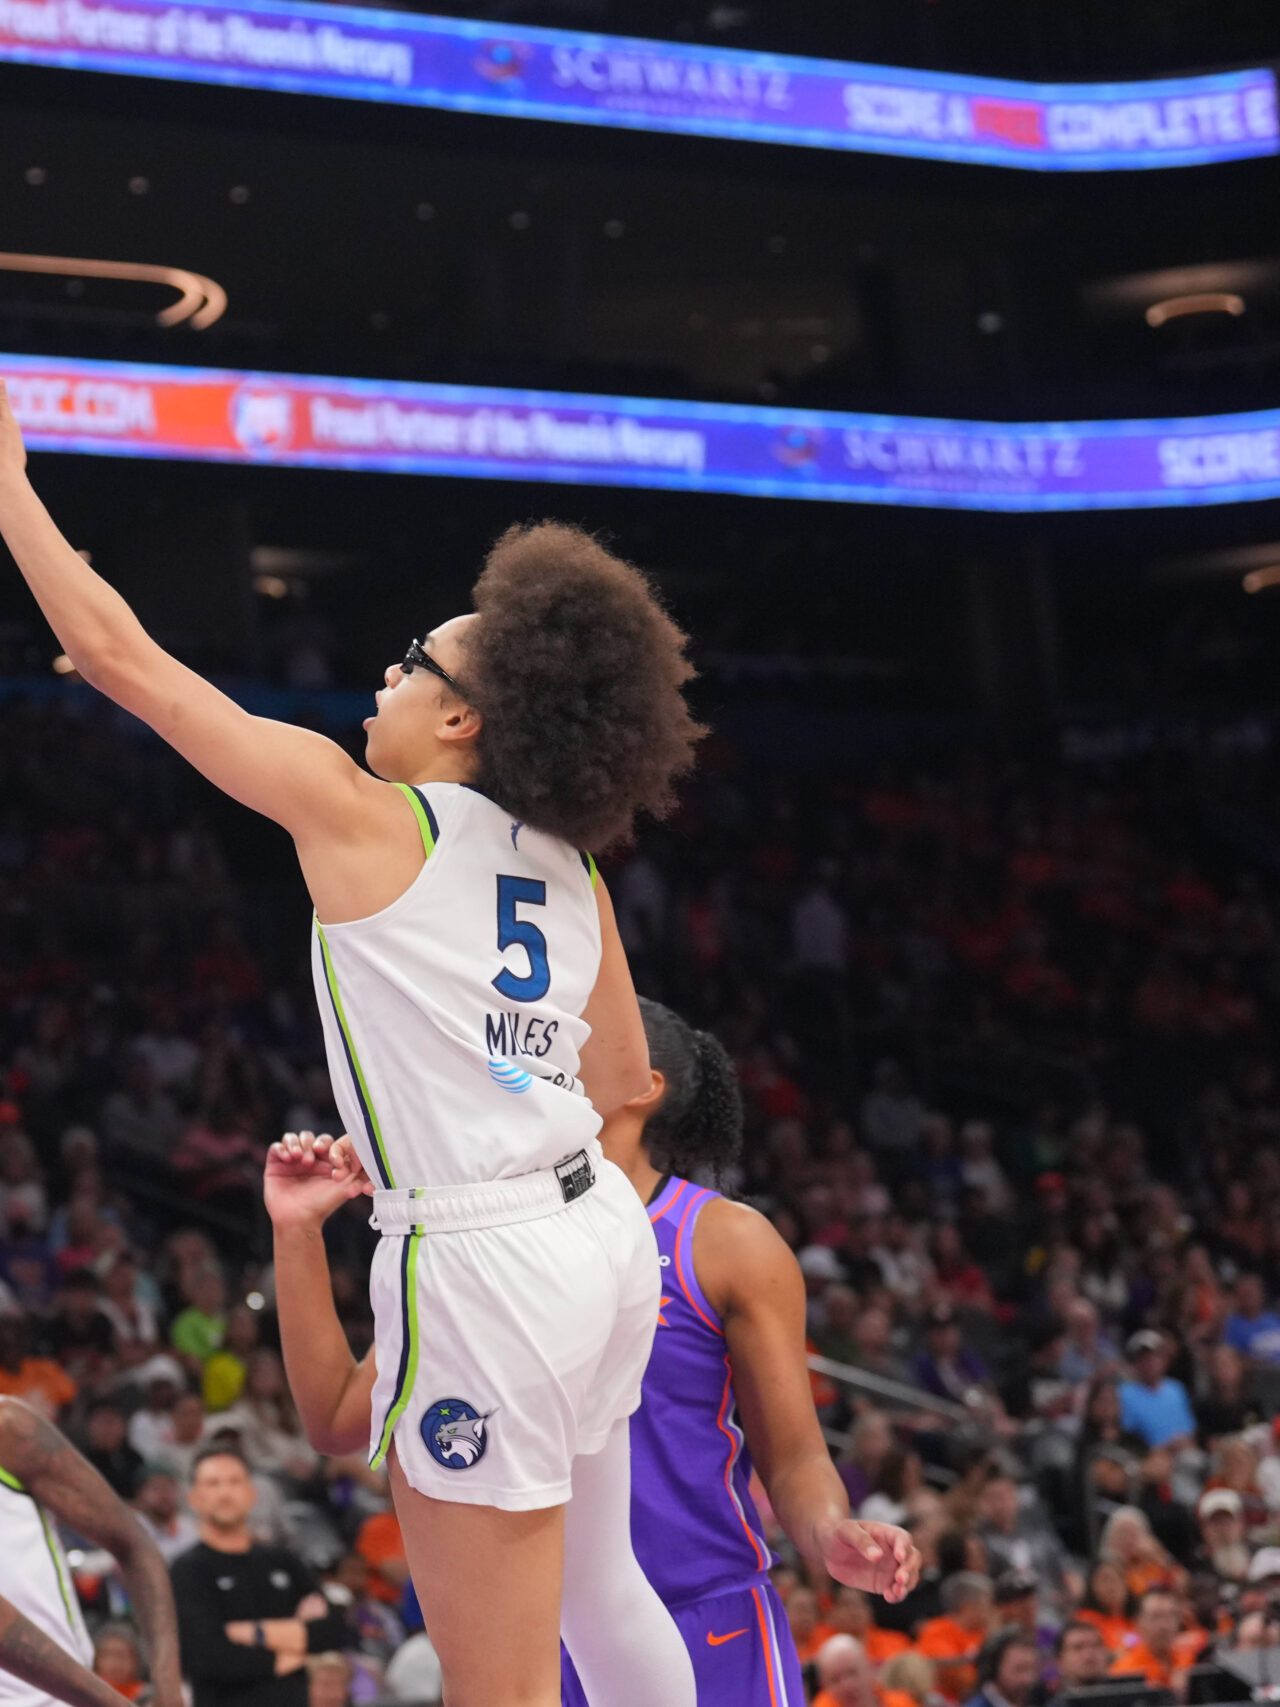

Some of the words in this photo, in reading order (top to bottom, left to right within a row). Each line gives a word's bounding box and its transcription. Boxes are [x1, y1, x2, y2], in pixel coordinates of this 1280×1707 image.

[551, 46, 792, 111] SCHWARTZ
[842, 426, 1087, 479] SCHWARTZ
[491, 874, 551, 1003] 5
[485, 1011, 560, 1059] MILES
